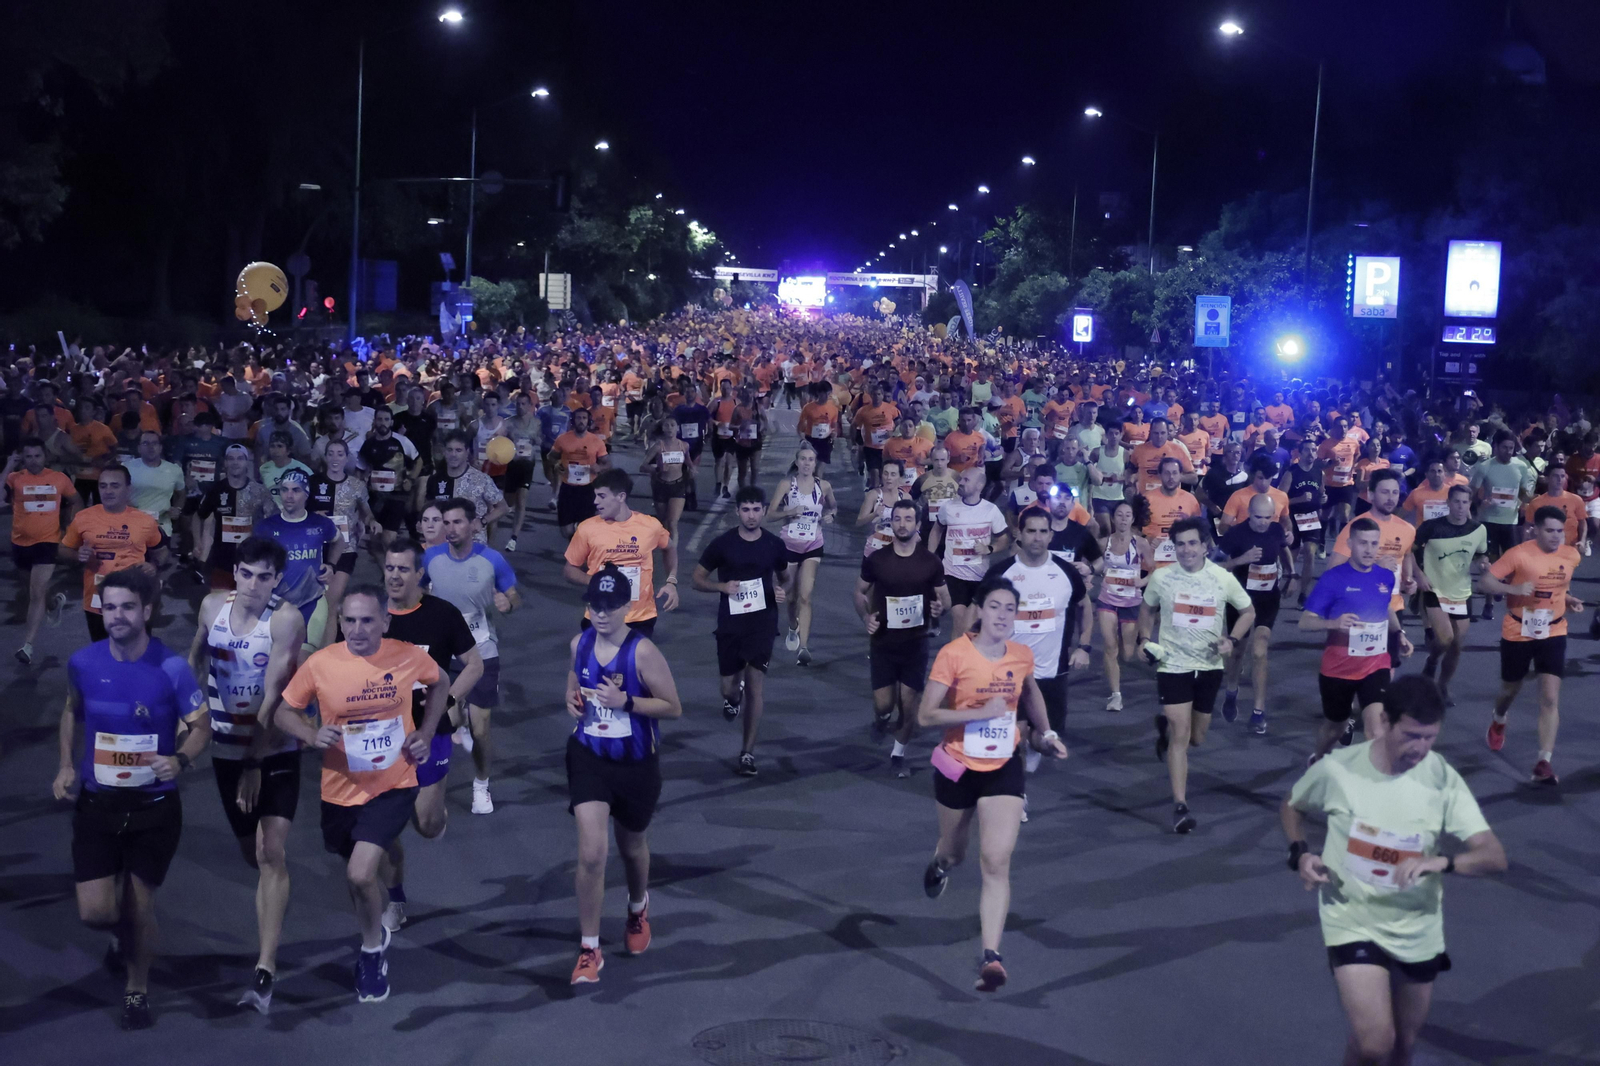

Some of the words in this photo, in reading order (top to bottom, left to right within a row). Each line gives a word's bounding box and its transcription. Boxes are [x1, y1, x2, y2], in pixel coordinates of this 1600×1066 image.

[1366, 261, 1391, 296] P
[1361, 306, 1386, 317] saba
[797, 522, 811, 531] 5303
[599, 580, 615, 593] 02
[735, 591, 758, 602] 15119
[895, 605, 917, 616] 15117
[1027, 611, 1043, 621] 707
[1188, 605, 1204, 615] 708
[226, 685, 260, 697] 14712
[362, 685, 398, 695] NOCTURNA
[346, 694, 379, 703] SEVILLA
[379, 691, 397, 700] KH7
[978, 726, 1009, 739] 18575
[362, 735, 392, 751] 7178
[112, 752, 142, 766] 1057
[1371, 845, 1400, 865] 660
